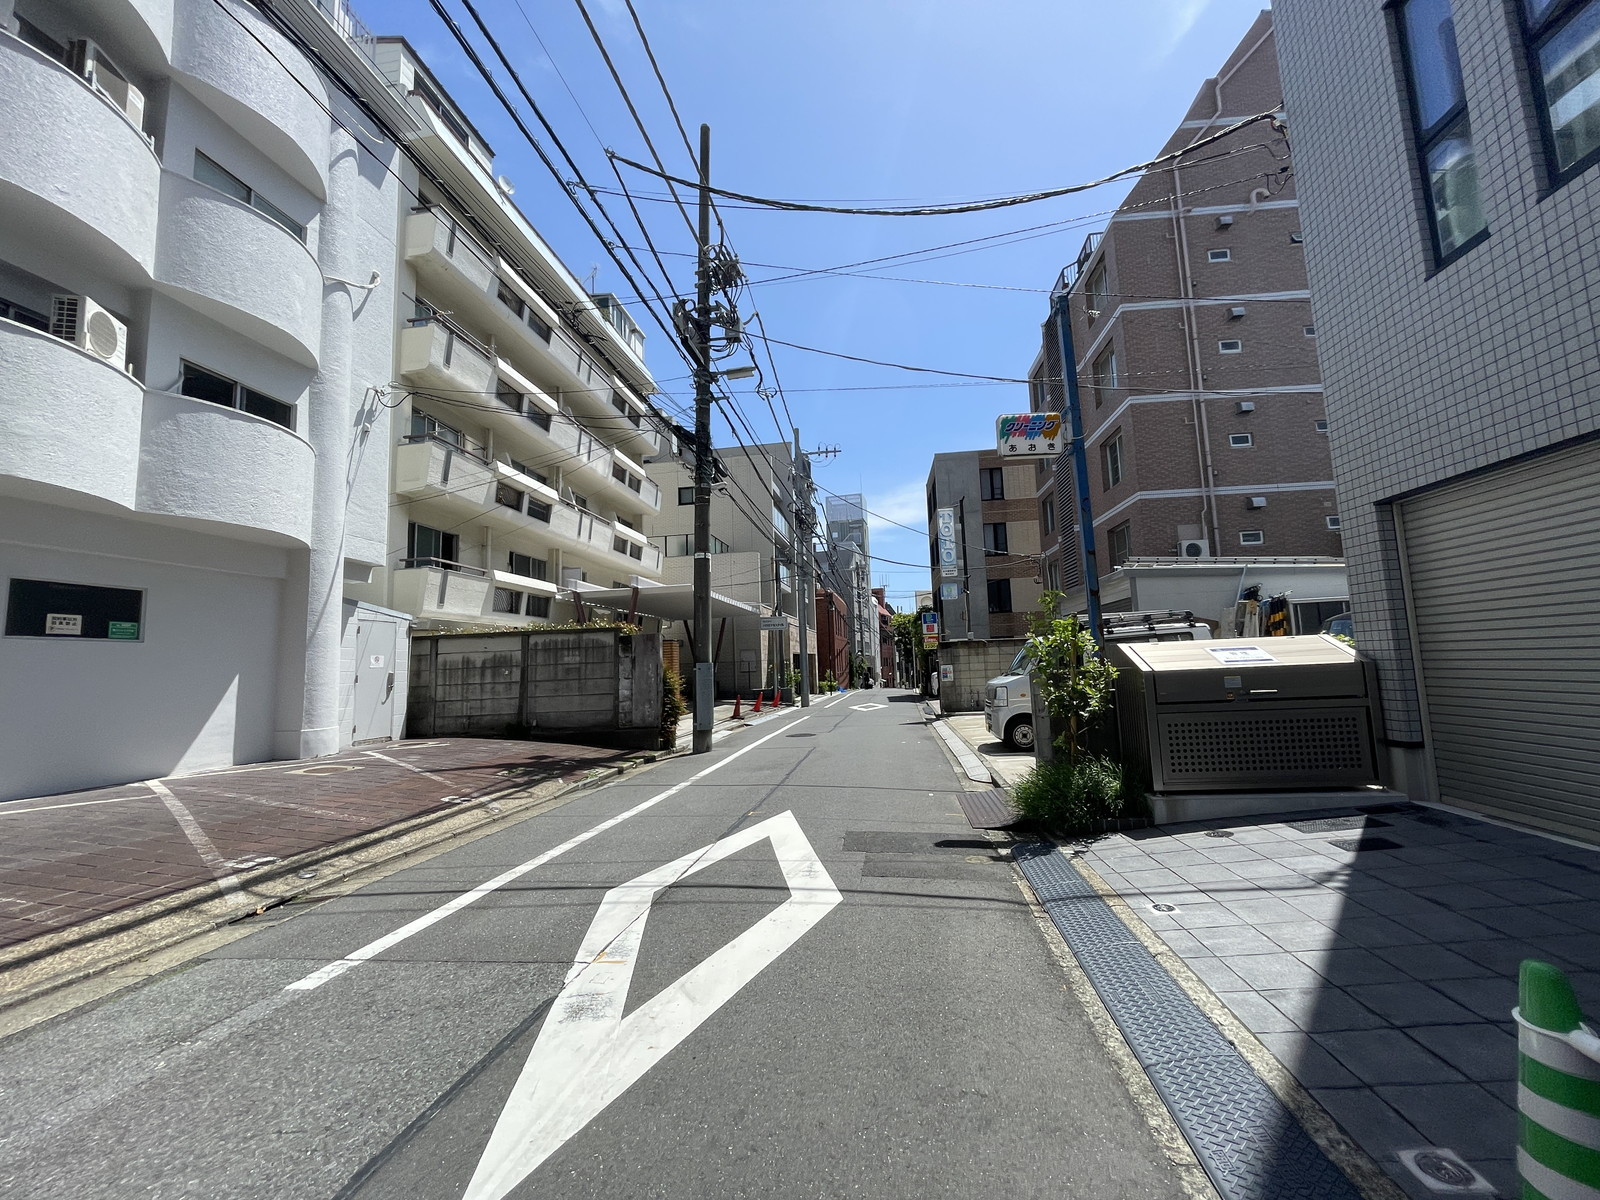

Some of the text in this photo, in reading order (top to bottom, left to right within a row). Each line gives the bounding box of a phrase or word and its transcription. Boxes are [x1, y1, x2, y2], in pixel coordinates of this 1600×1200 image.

[1005, 420, 1058, 432] クリーニング
[1009, 443, 1056, 452] あおき
